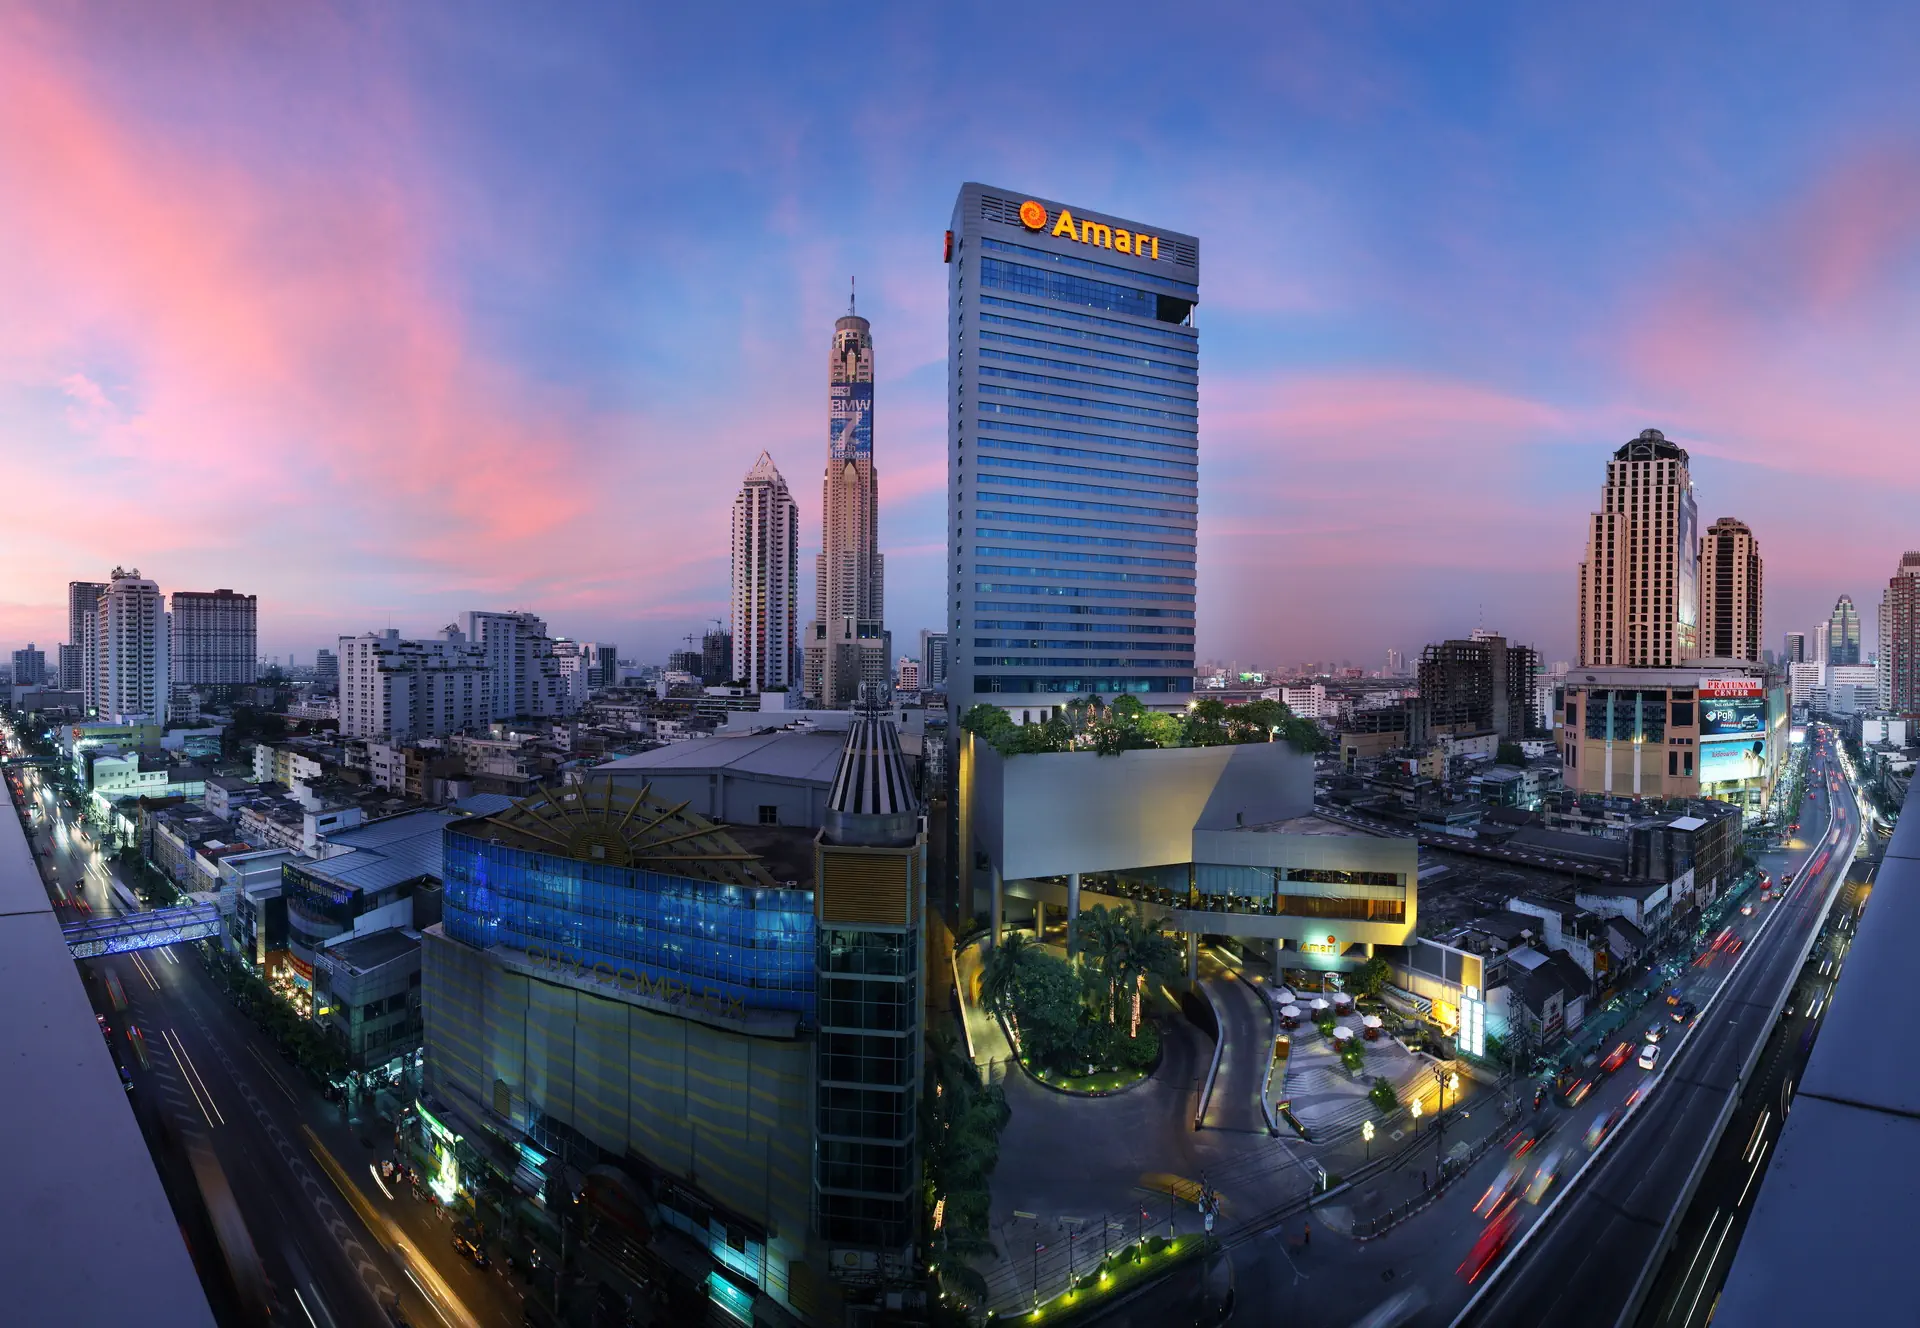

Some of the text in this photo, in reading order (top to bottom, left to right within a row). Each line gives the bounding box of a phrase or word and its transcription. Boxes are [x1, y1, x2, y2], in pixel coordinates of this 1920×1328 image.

[1051, 209, 1159, 260] Amari
[831, 399, 872, 411] BMW
[831, 443, 871, 459] heaven
[1707, 681, 1757, 689] PRATUNAM
[1299, 941, 1336, 953] Amari
[525, 945, 747, 1018] CITY COMPLEX
